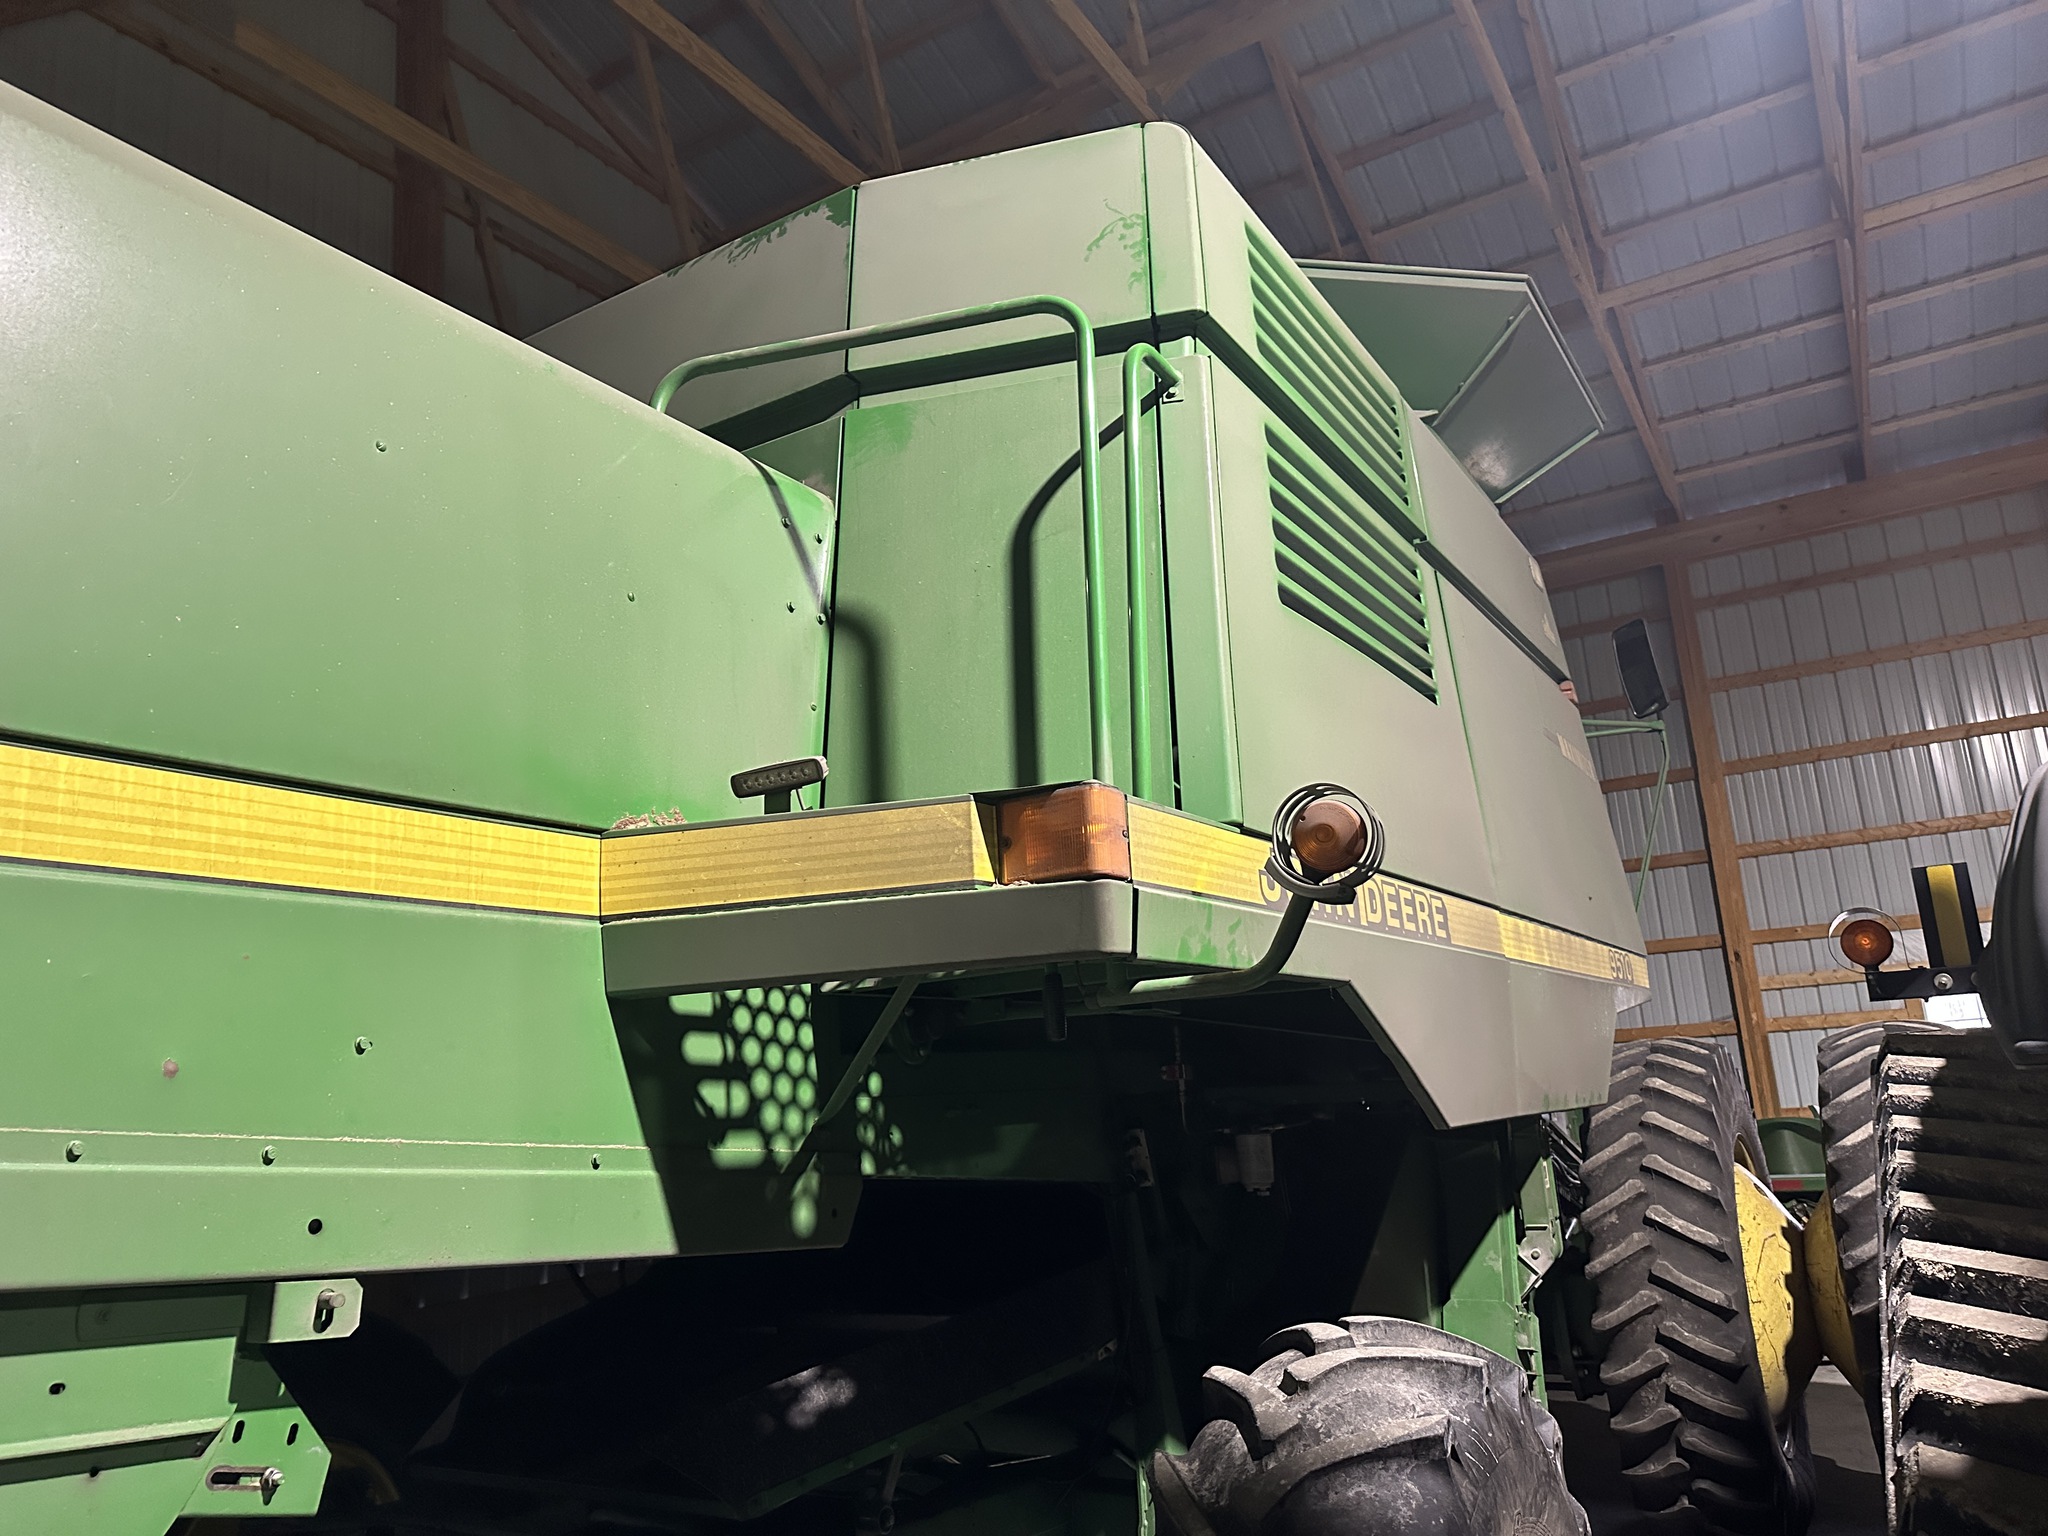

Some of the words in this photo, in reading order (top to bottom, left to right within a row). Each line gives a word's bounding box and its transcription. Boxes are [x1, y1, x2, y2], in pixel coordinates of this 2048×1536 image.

[1260, 847, 1356, 919] JN
[1364, 878, 1447, 939] DEERE
[1608, 948, 1634, 983] 9510
